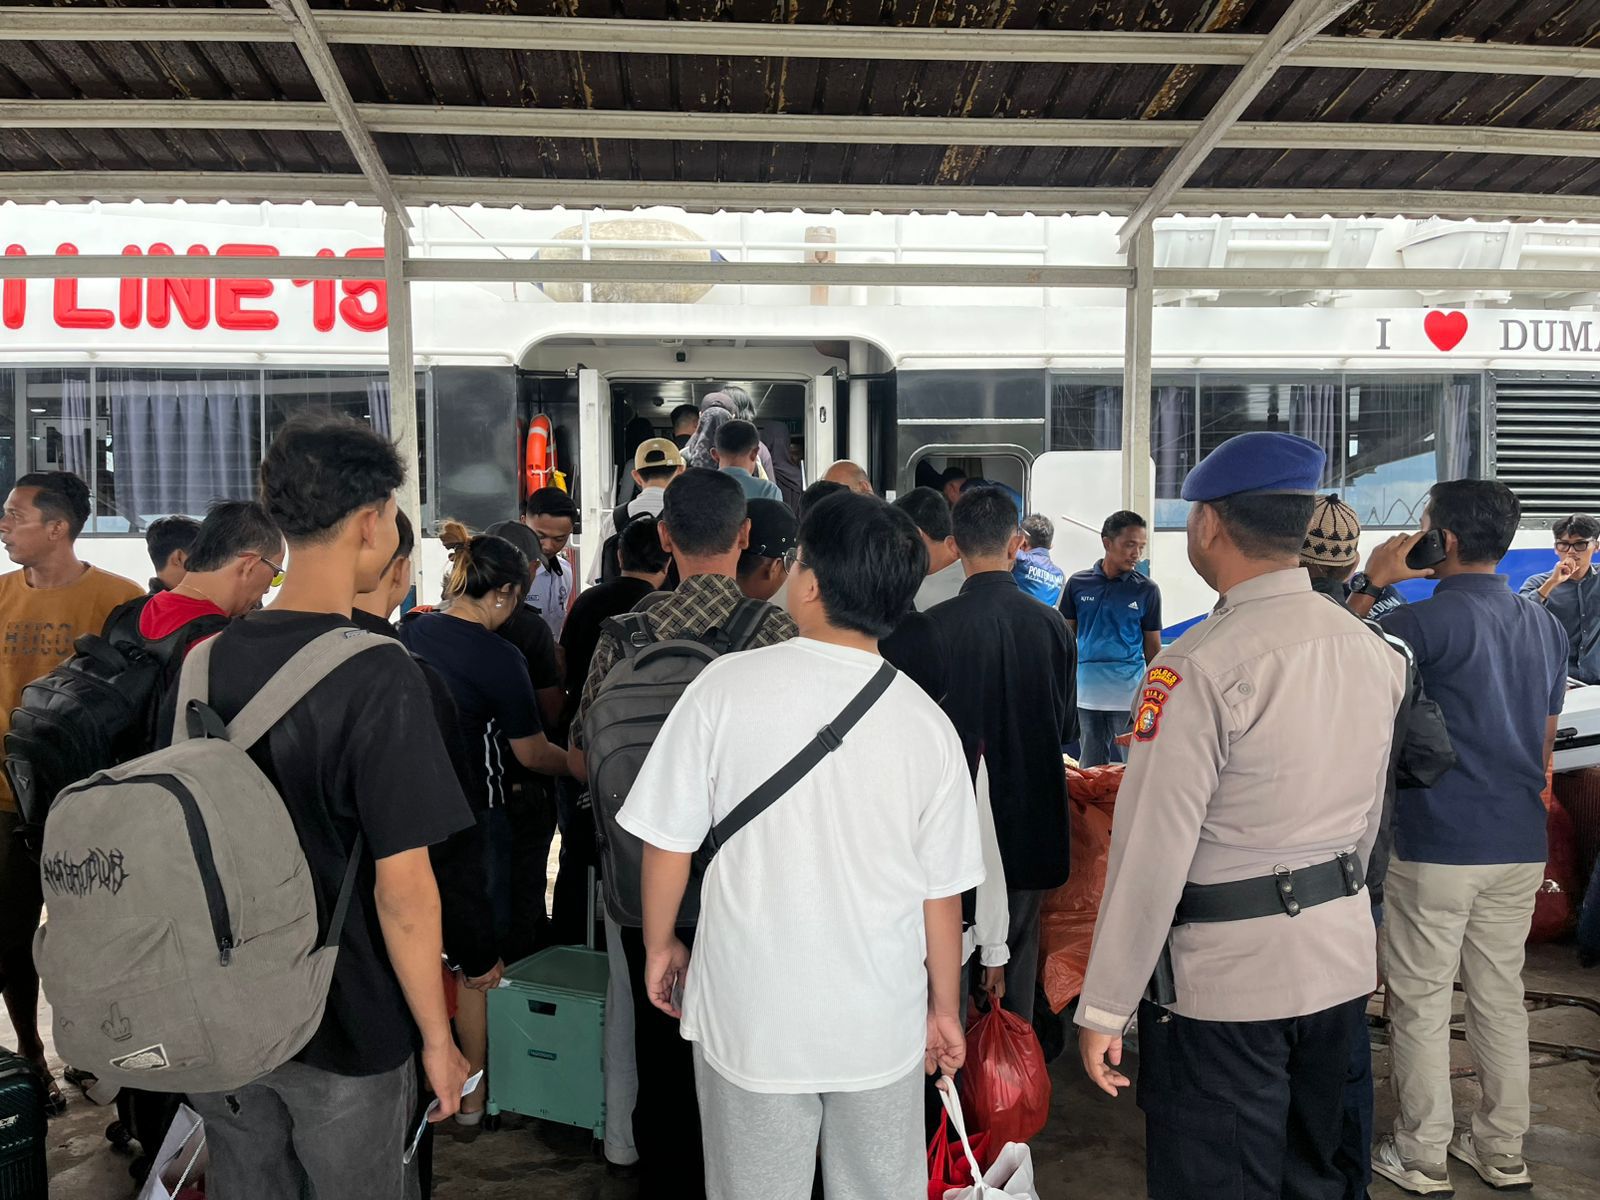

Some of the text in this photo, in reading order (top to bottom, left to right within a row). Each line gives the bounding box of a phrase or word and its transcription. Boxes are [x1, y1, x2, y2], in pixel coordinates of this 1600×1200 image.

[54, 243, 280, 330] LINE
[290, 248, 388, 332] 15
[1376, 318, 1600, 352] I DUM
